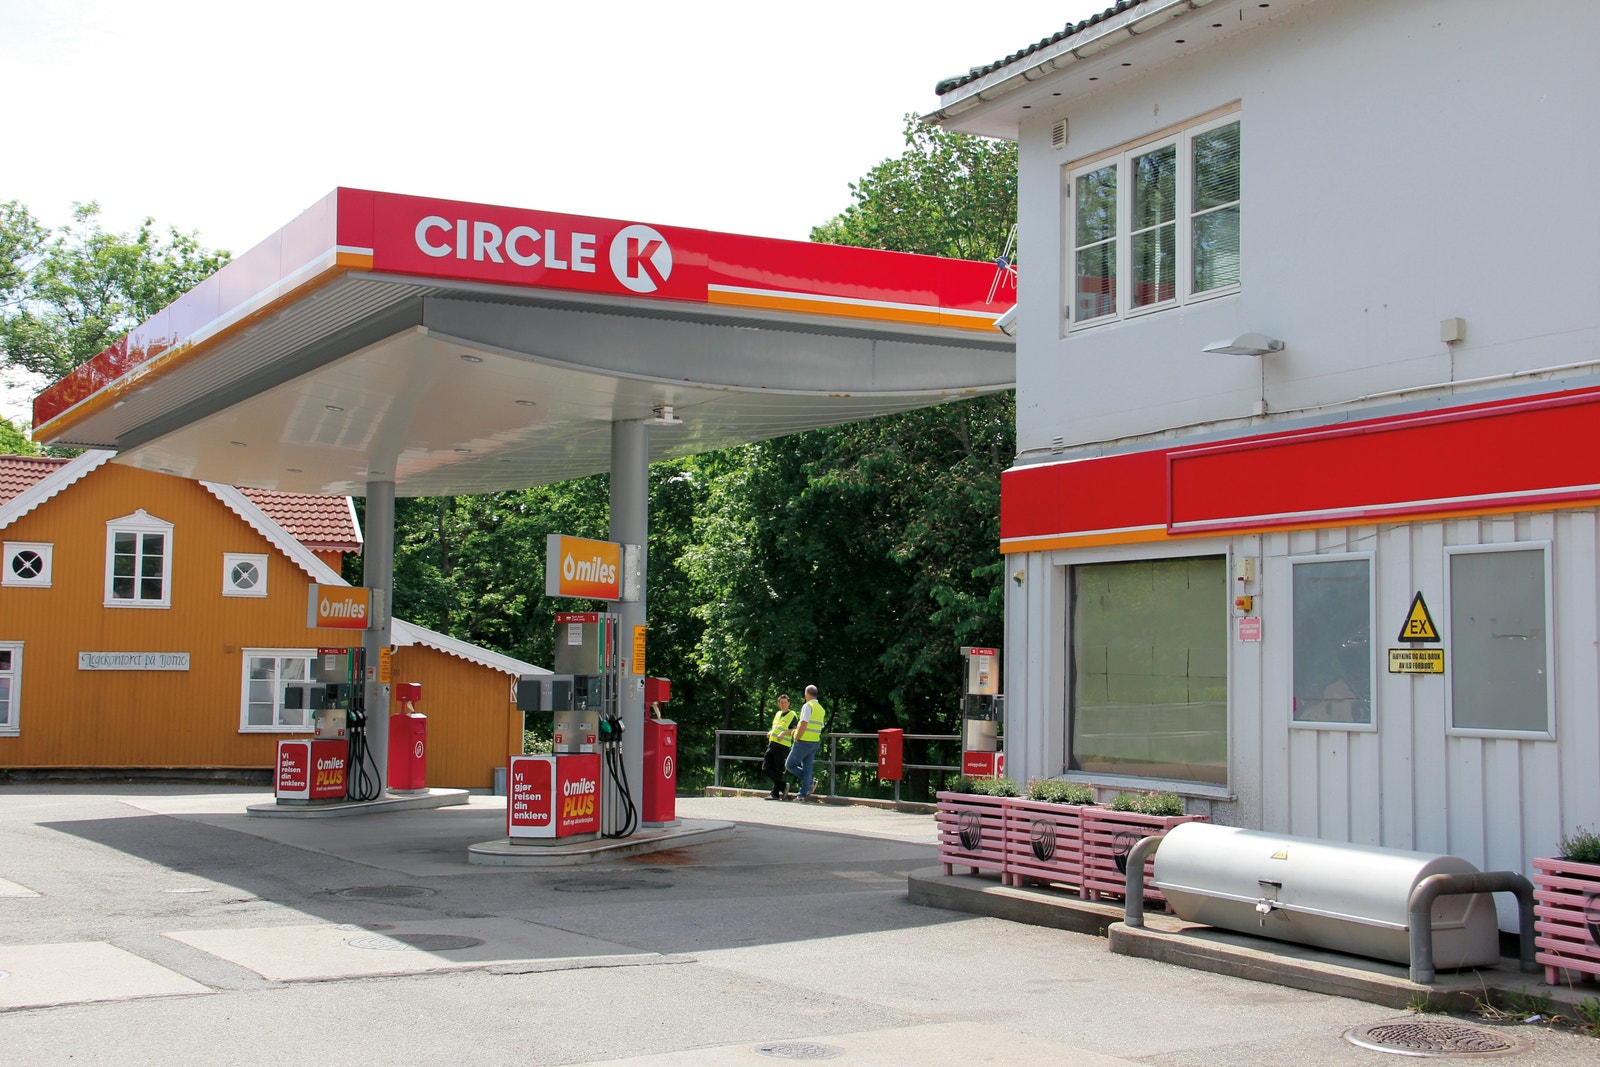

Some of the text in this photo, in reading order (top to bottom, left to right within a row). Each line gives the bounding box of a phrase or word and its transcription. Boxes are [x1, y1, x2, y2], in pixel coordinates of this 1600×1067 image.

[414, 215, 668, 290] CIRCLE K
[575, 556, 616, 584] miles
[330, 598, 365, 618] miles
[1410, 620, 1428, 634] EX
[323, 757, 344, 769] miles
[316, 770, 343, 785] PLUS
[514, 772, 523, 781] Vi
[514, 783, 532, 792] gjør
[570, 778, 596, 794] miles
[514, 792, 542, 800] reisen
[514, 801, 528, 810] din
[563, 795, 595, 818] PLUS
[513, 811, 548, 820] enklere
